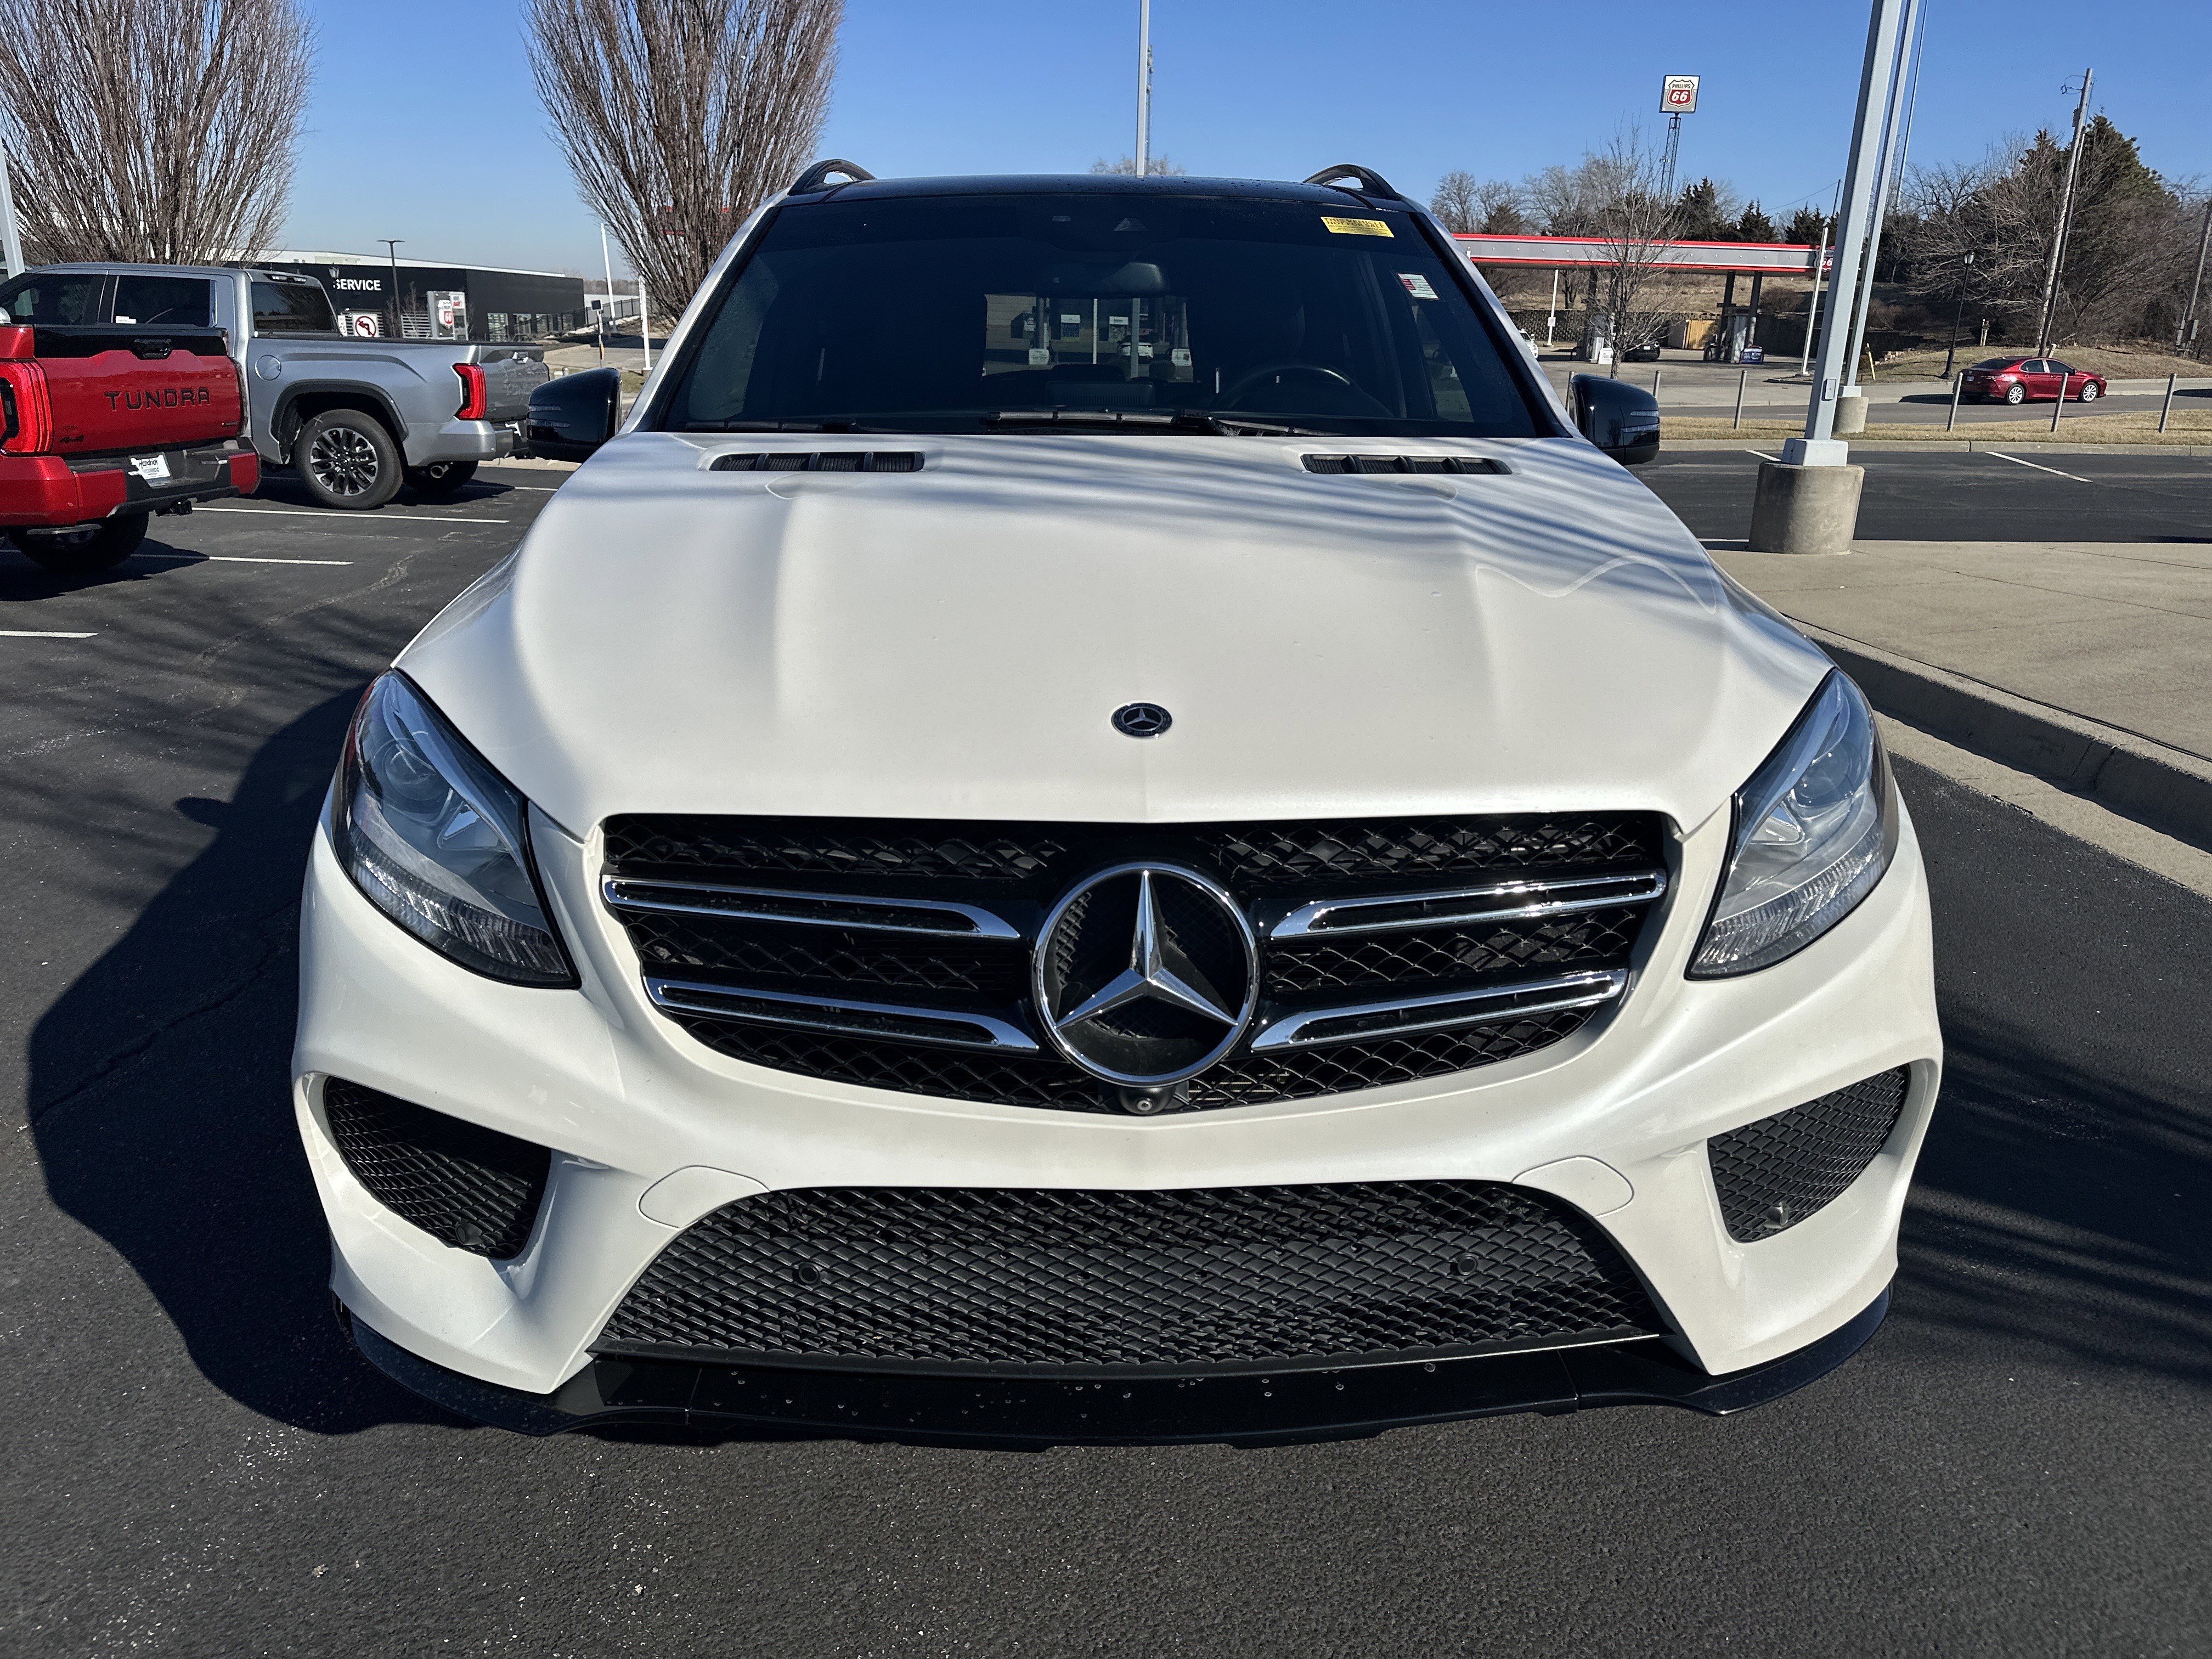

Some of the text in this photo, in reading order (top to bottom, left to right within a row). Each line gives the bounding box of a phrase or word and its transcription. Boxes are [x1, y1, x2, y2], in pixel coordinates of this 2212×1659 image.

[1671, 91, 1689, 101] 66
[333, 279, 381, 291] SERVICE
[104, 386, 211, 411] TUNDRA
[139, 458, 158, 469] Hendrick
